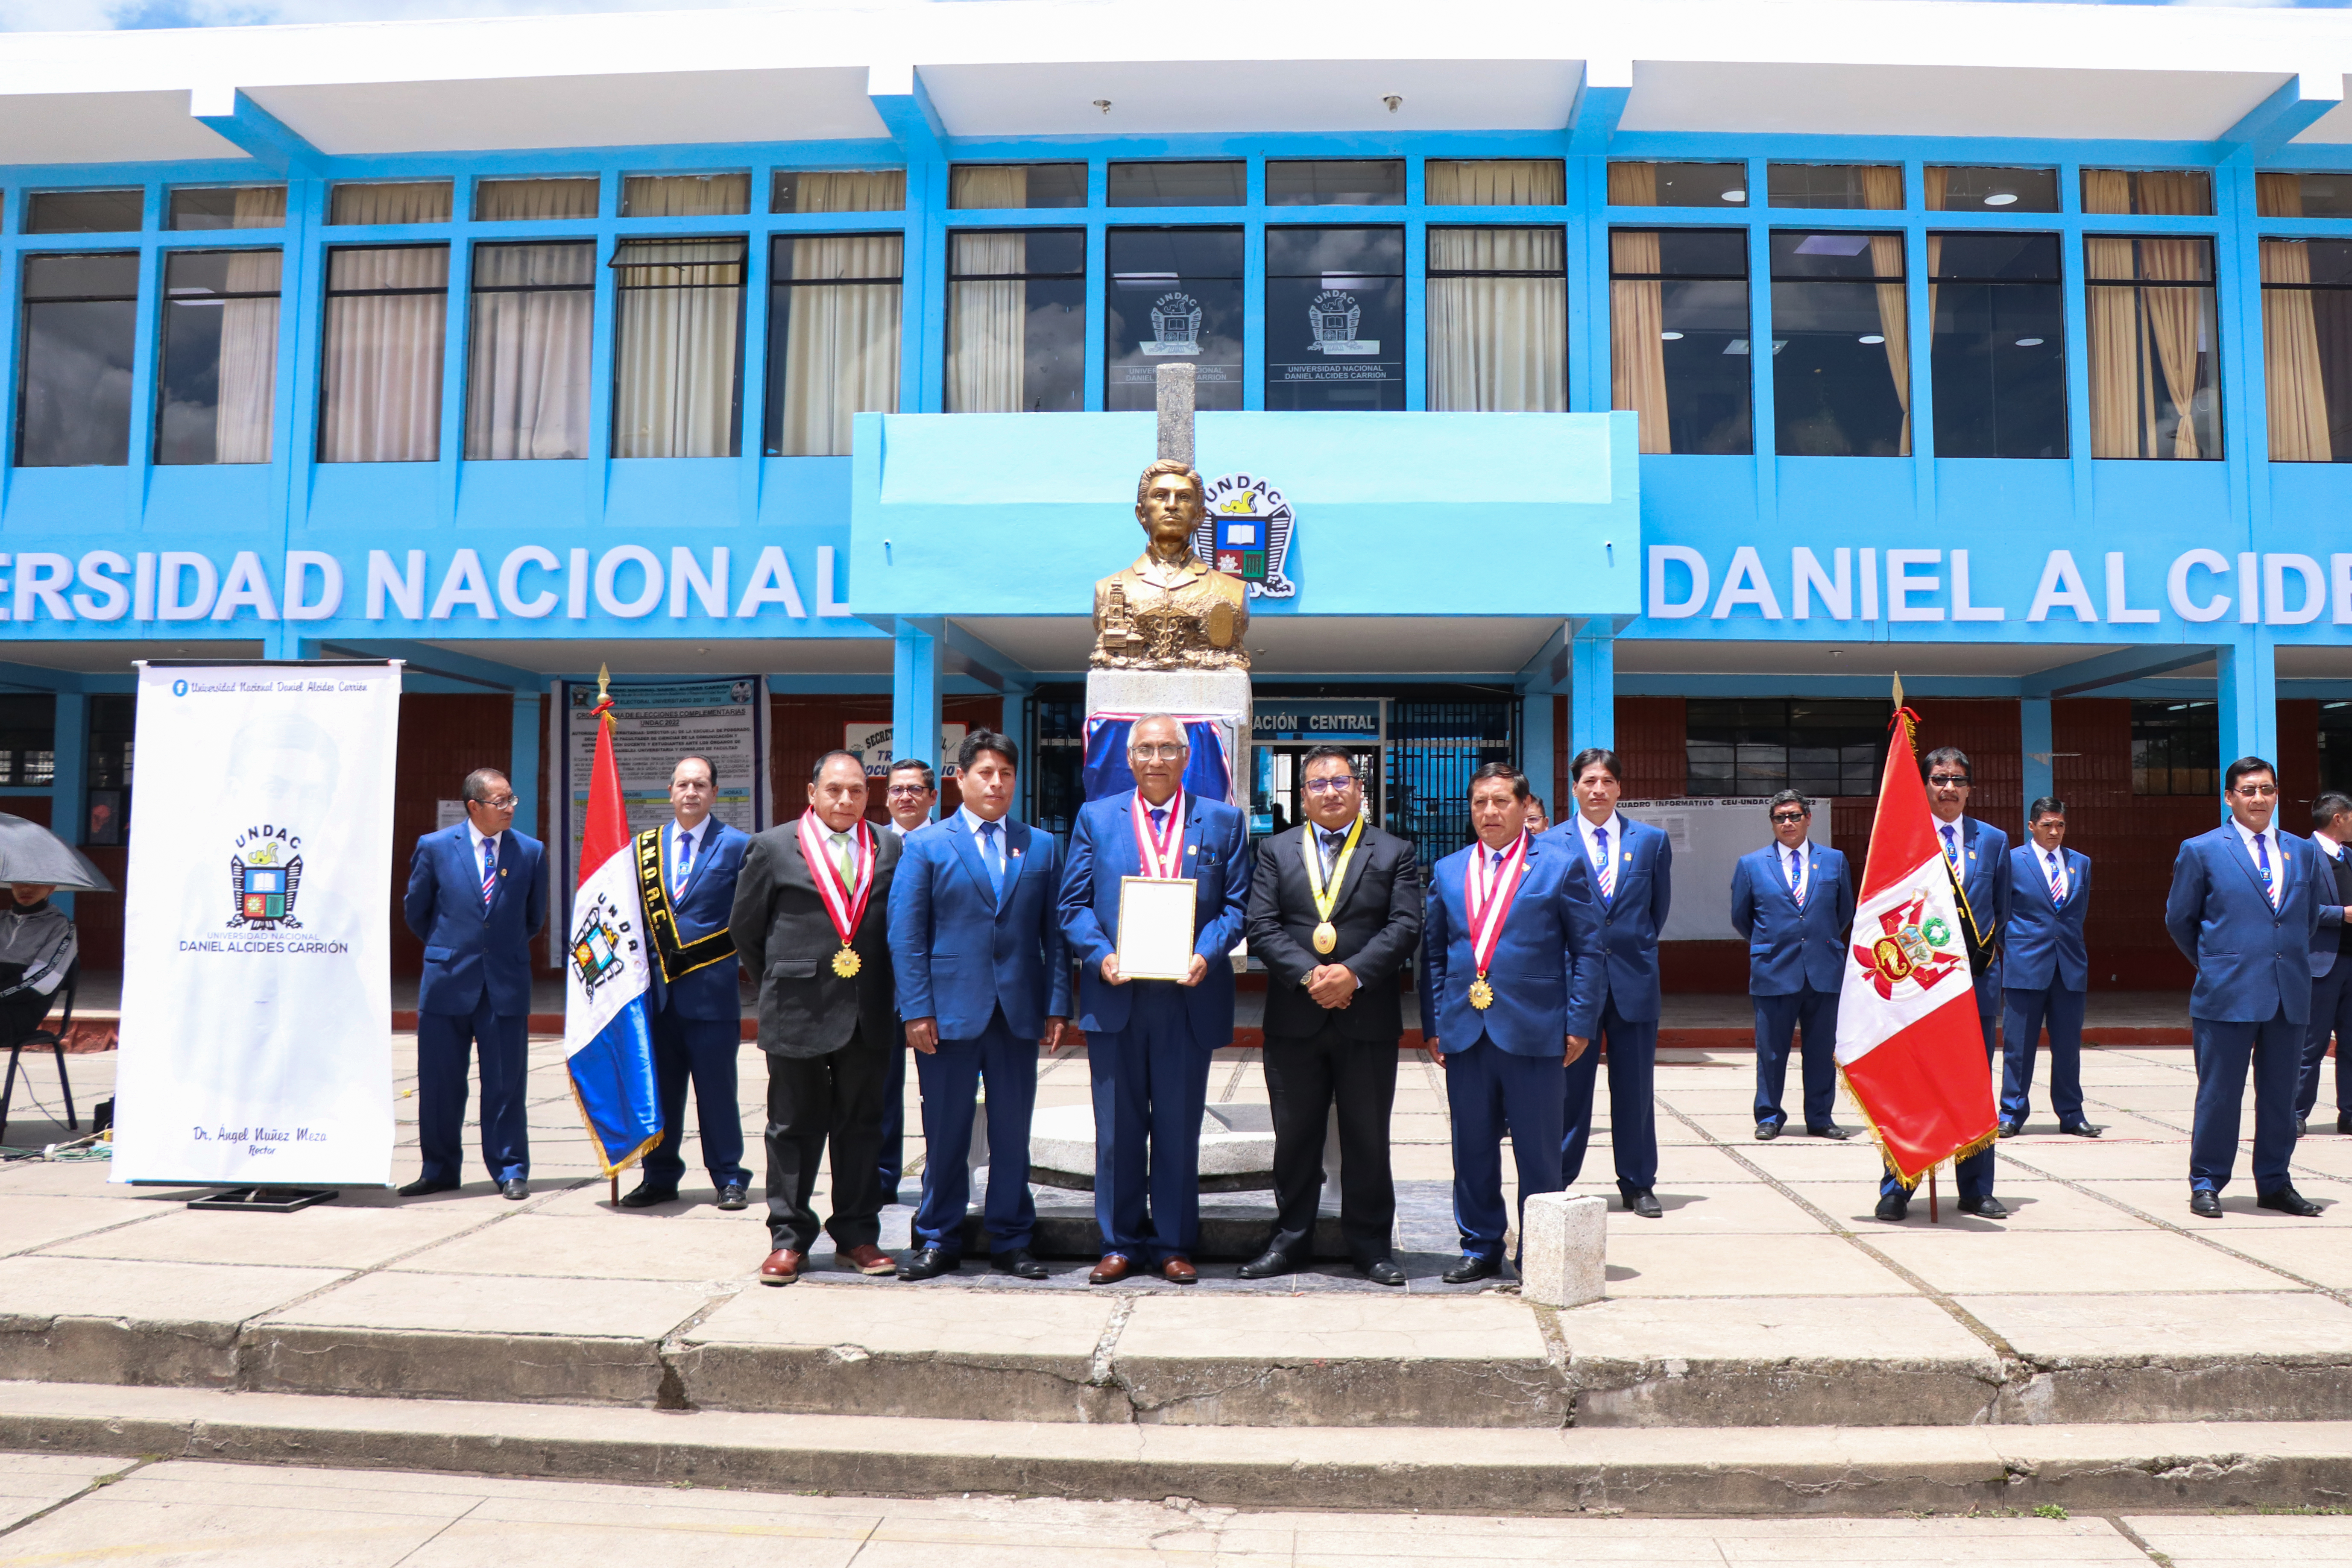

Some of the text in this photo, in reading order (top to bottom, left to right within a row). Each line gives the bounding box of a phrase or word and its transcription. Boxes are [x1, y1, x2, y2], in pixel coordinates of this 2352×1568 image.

[1156, 292, 1197, 307] UNDAC
[1314, 290, 1355, 304] UNDAC
[0, 550, 343, 621] RSIDAD
[366, 545, 849, 619] NACIONAL
[1648, 545, 2004, 622] DANIEL
[191, 682, 235, 692] Universidad
[240, 682, 274, 692] Nacional
[278, 681, 304, 692] Daniel
[307, 682, 334, 692] Alcides
[680, 709, 746, 717] COMPLEMENTARIAS
[1310, 715, 1375, 730] CENTRAL
[865, 727, 893, 749] SECRET
[235, 824, 302, 849] UNDAC
[179, 940, 348, 953] DANIEL ALCIDES CARRIÓN
[193, 1126, 212, 1141] Dr.
[217, 1123, 250, 1144] Ángel
[296, 1127, 328, 1141] Meza
[248, 1144, 277, 1156] Rector
